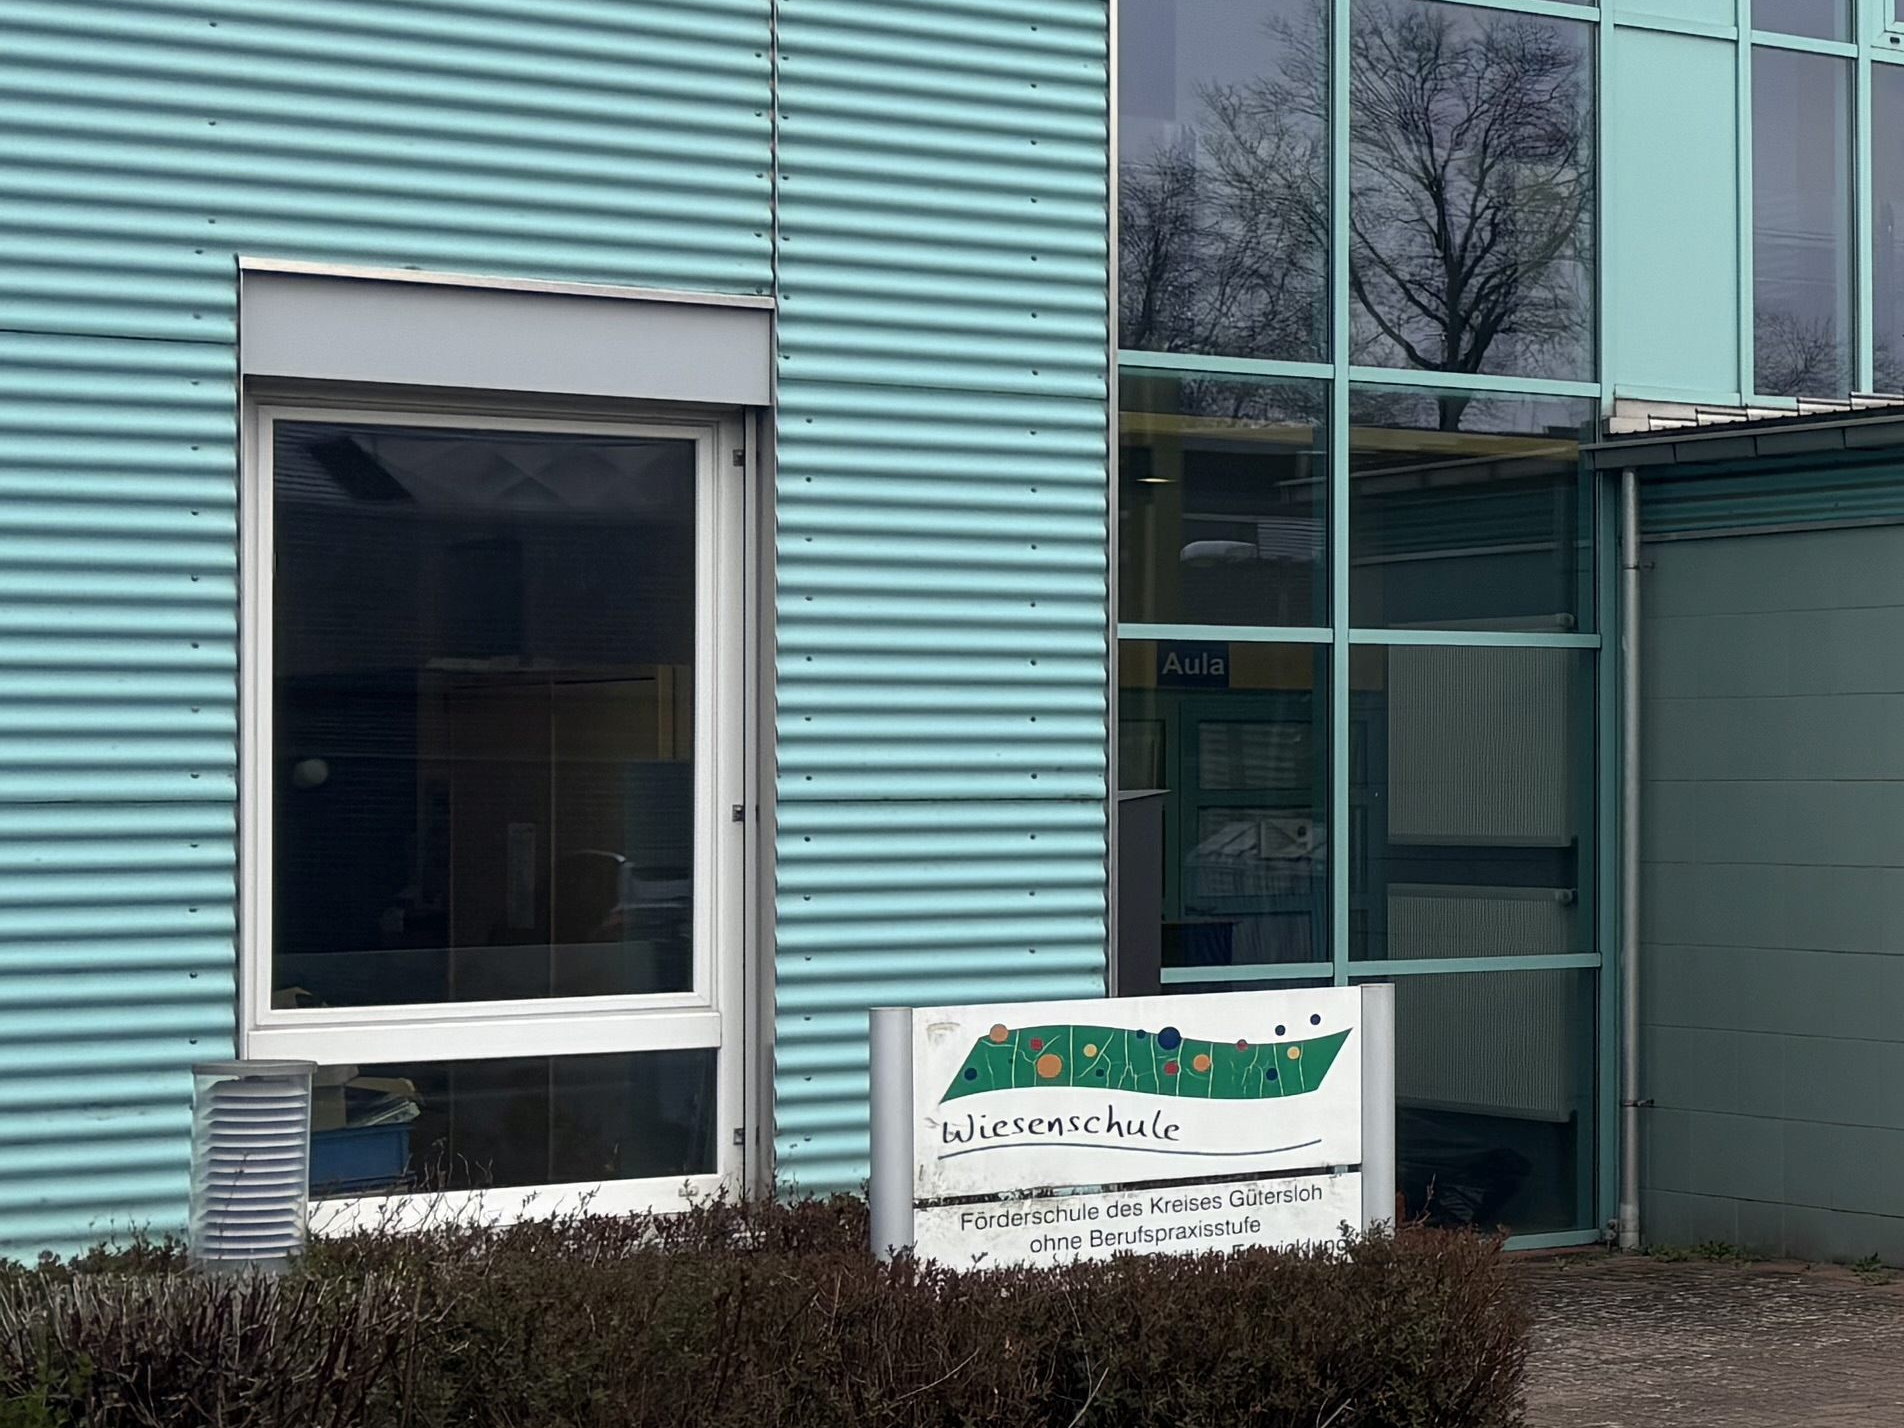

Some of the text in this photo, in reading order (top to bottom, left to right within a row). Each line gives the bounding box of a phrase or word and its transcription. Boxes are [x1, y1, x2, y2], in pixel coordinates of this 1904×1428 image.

[1162, 652, 1224, 675] Aula
[942, 1104, 1180, 1143] Wiesenschule
[960, 1184, 1323, 1231] Förderschule des Kreises Gütersloh
[1030, 1216, 1261, 1253] ohne Berufspraxisstufe
